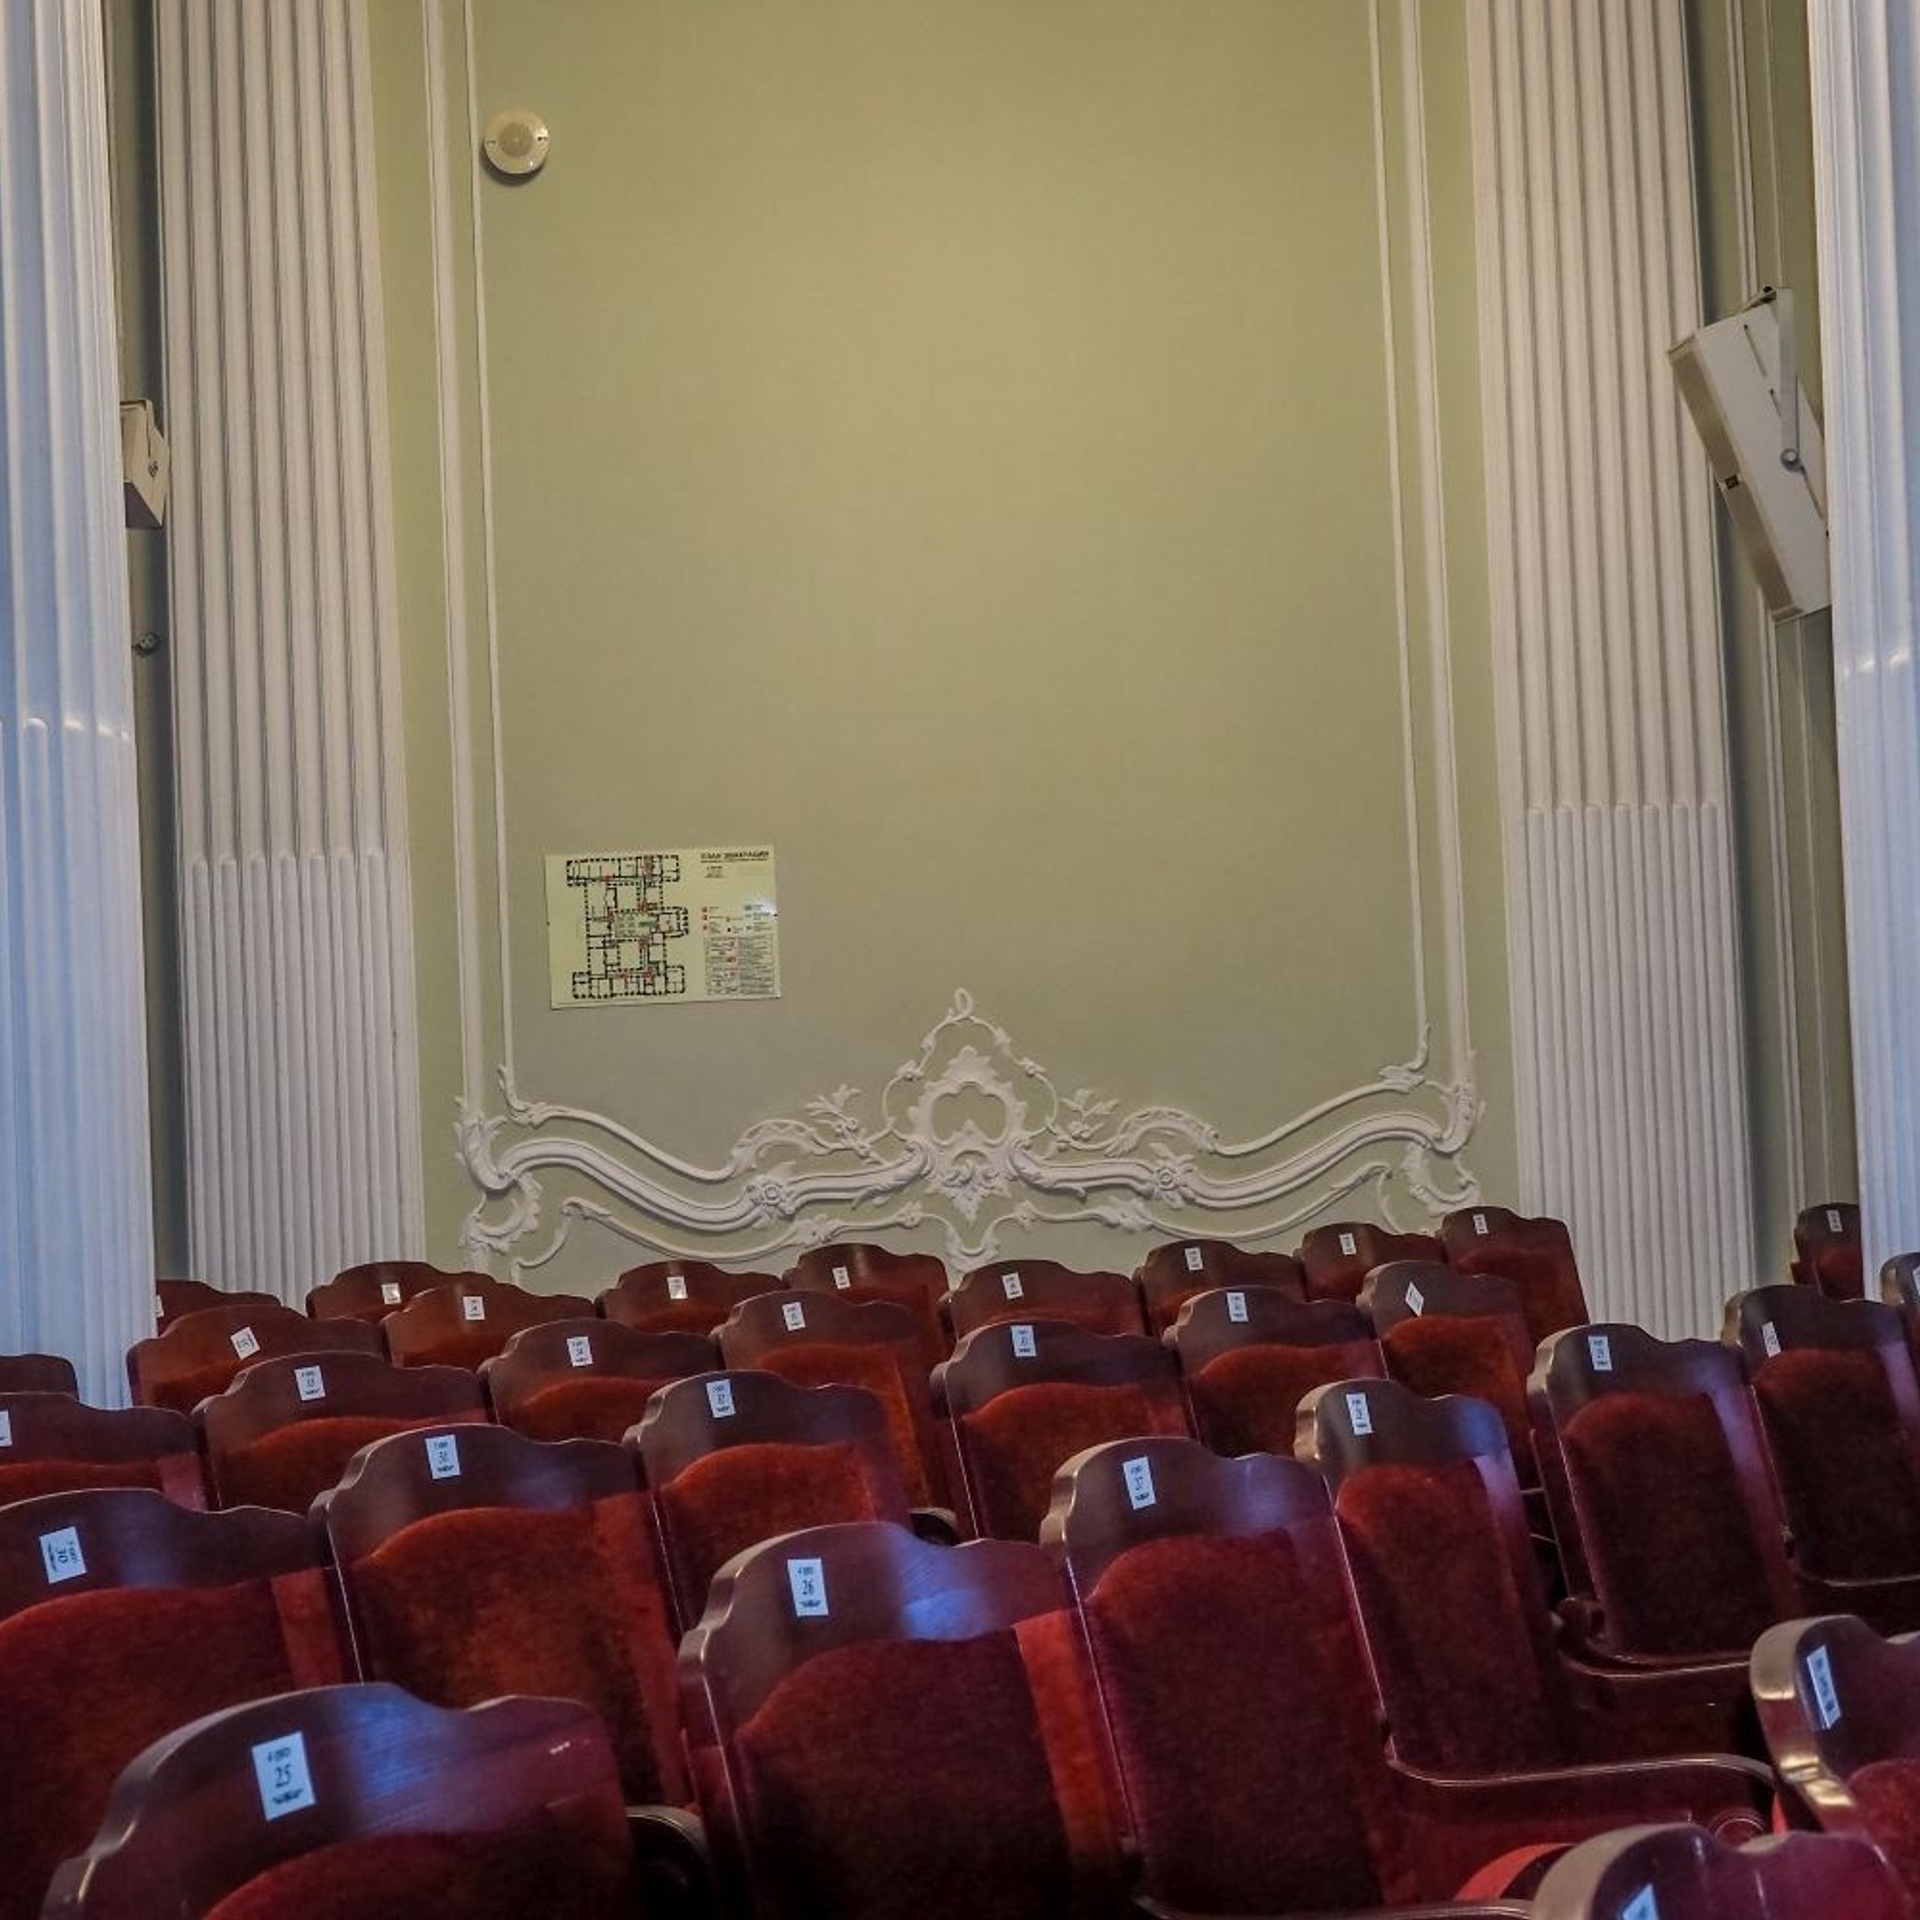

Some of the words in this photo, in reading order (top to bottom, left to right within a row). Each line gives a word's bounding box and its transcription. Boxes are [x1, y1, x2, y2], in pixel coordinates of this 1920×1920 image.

[56, 1547, 69, 1564] 30
[802, 1579, 815, 1597] 26
[275, 1763, 291, 1788] 25
